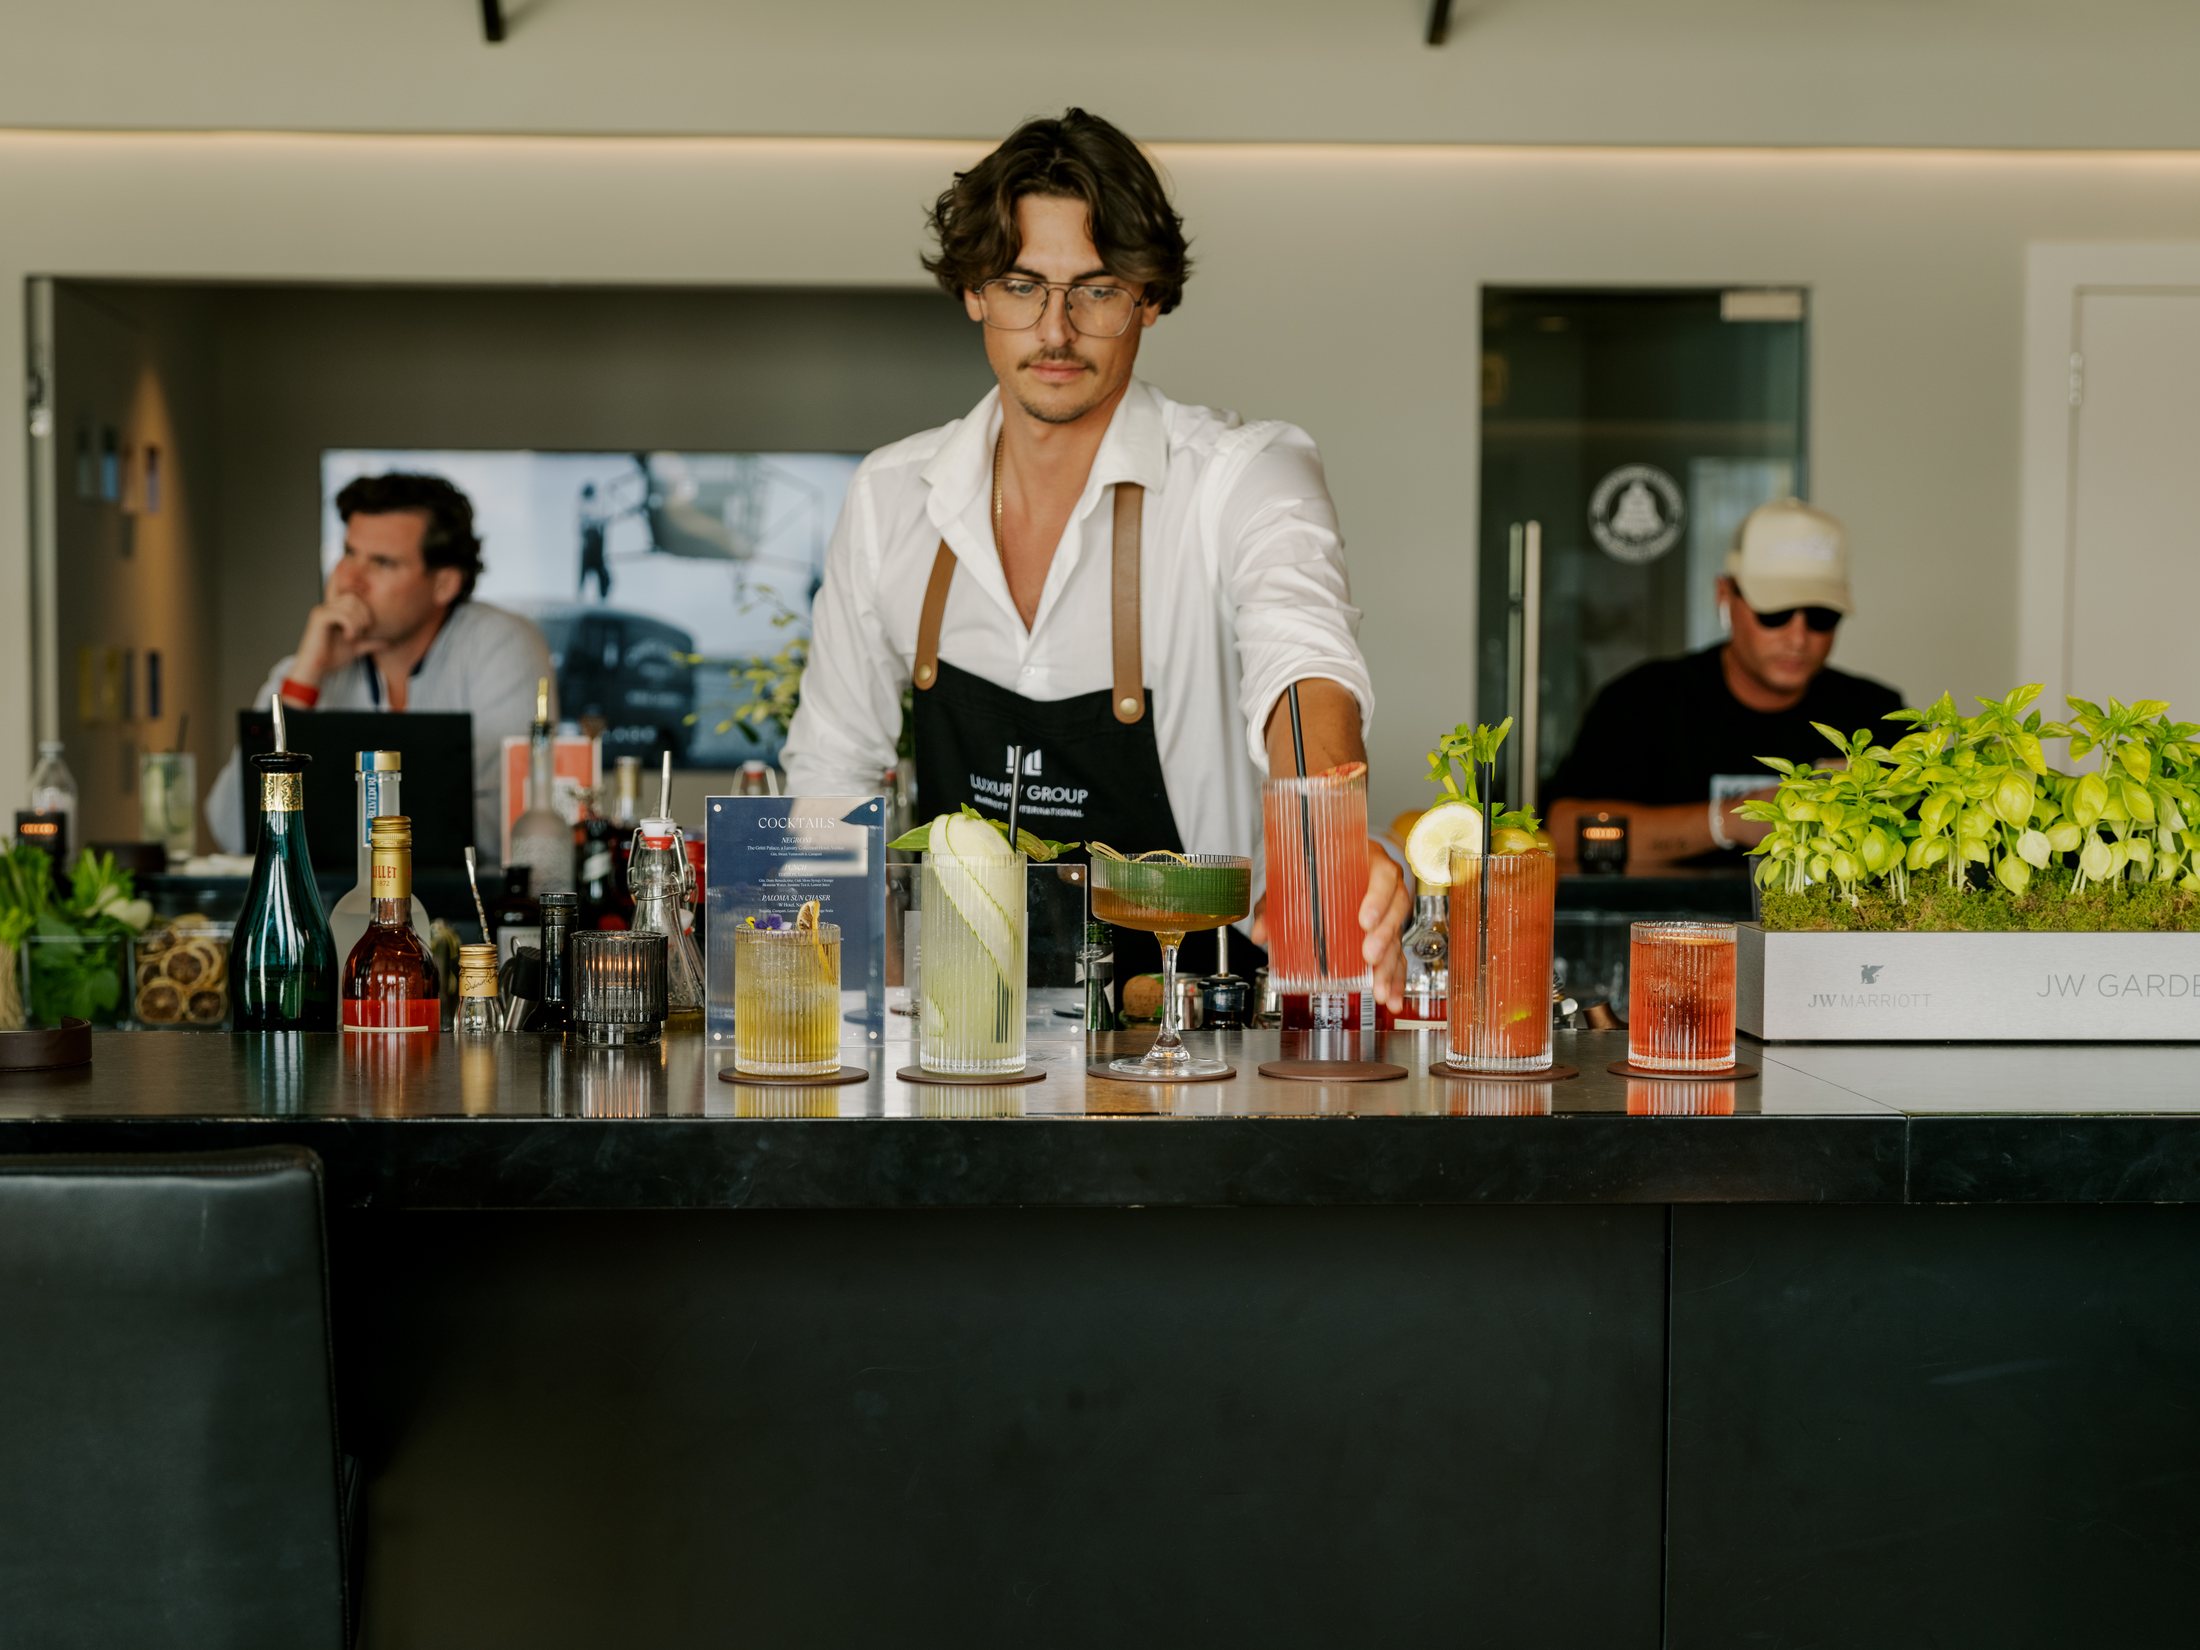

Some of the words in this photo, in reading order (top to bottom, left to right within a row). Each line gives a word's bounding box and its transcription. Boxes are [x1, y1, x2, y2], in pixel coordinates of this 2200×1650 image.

[1027, 785, 1088, 804] GROUP
[758, 817, 835, 829] COCKTAILS
[2036, 974, 2086, 998] JW
[1807, 993, 1837, 1008] JW
[1840, 993, 1932, 1008] MARRIOTT
